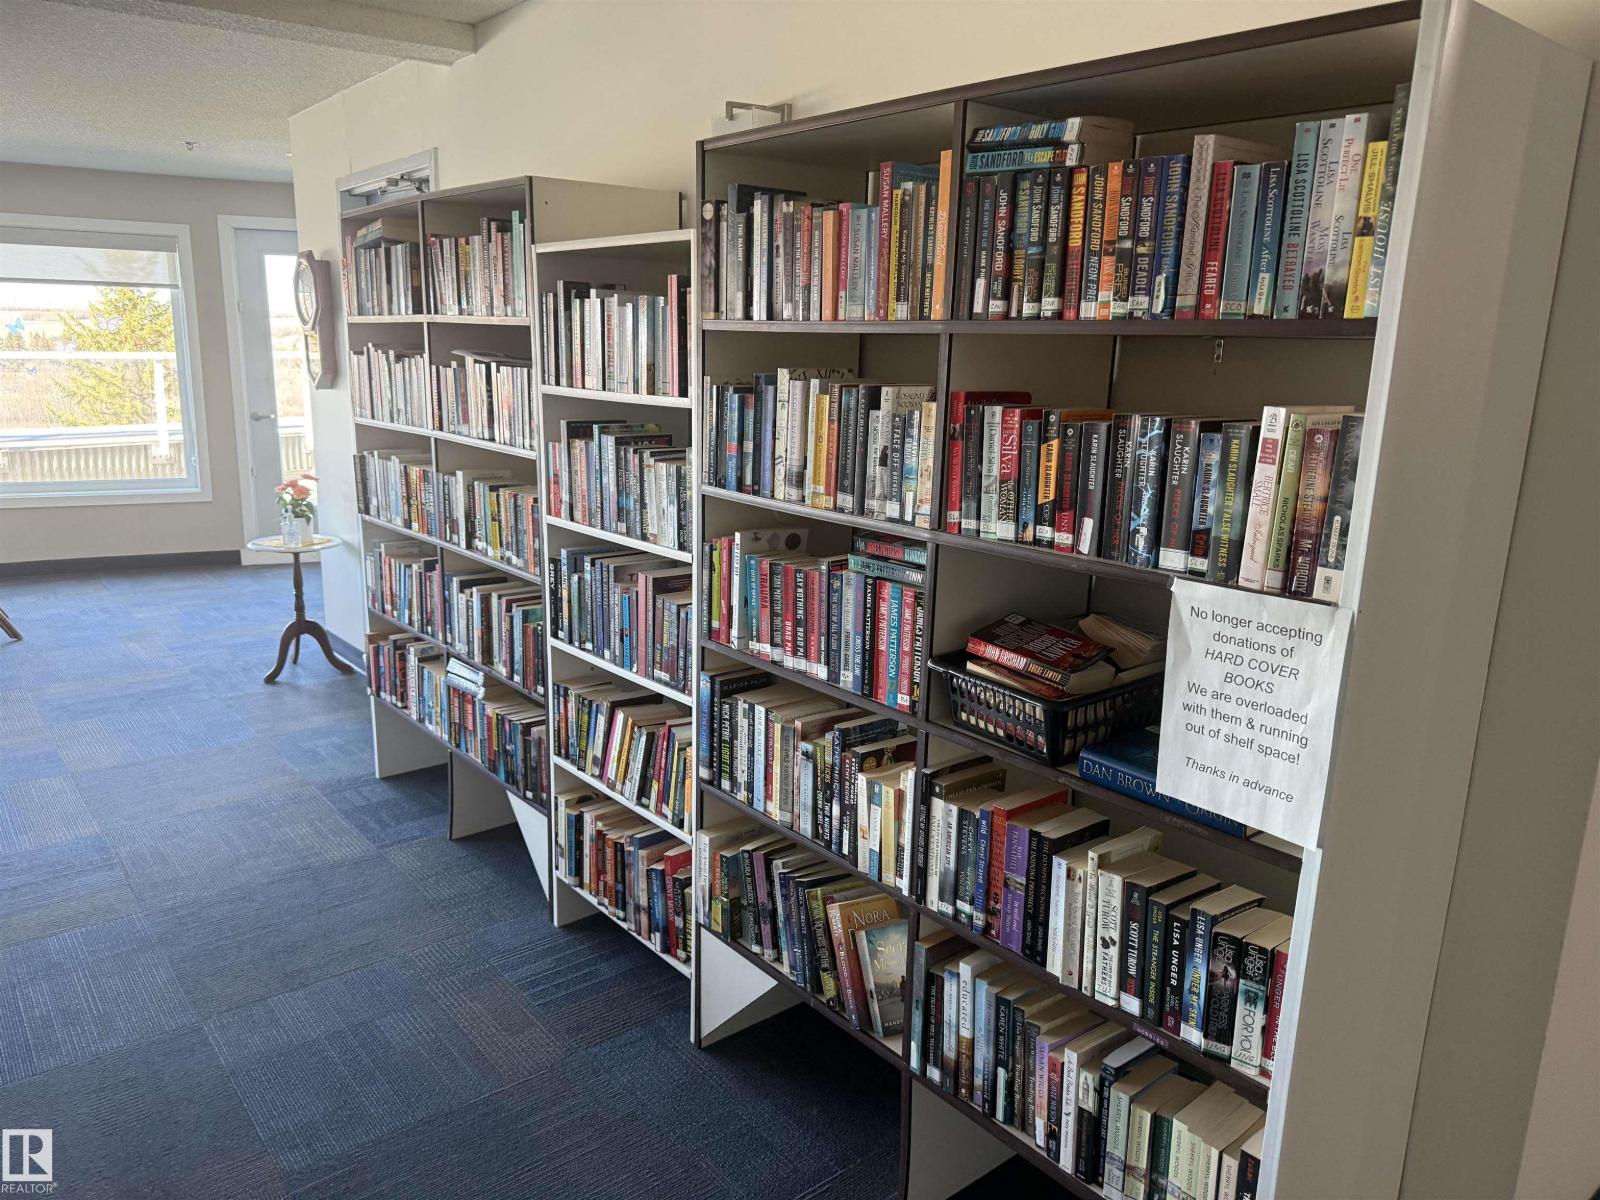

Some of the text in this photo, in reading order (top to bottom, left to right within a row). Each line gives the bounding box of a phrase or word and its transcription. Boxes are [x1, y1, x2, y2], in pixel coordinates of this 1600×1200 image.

[979, 151, 1024, 169] SANDFORD
[1313, 138, 1333, 209] SCOTTOLINE
[1326, 161, 1338, 185] LISA
[1350, 153, 1361, 174] ONE
[1363, 149, 1378, 213] JILL SHALVIS
[881, 167, 891, 239] SUSAN MALLERY
[1030, 185, 1041, 242] JOHN SANDFORD
[1069, 187, 1087, 247] SANDFORD
[1119, 197, 1132, 236] SANDFORD
[1160, 160, 1182, 254] JOHN SANDFORD
[1259, 167, 1279, 273] LISA SCOTTOLINE After
[1282, 153, 1310, 291] LISA SCOTTOLINE BETRAYED
[994, 189, 1007, 271] JOHN SANDFORD
[1049, 205, 1060, 242] SANDFORD
[1088, 174, 1102, 280] JOHN SANDFORD NEON
[1329, 215, 1344, 266] SCOTTOLINE
[1340, 231, 1352, 250] LISA
[1134, 197, 1153, 297] SANDFORD DEADLI
[1366, 201, 1392, 307] LAST HOUSE
[851, 257, 859, 291] MALLERY
[1204, 261, 1217, 295] FEARED
[892, 429, 901, 468] FACE OFF
[1001, 435, 1017, 475] Silva
[1114, 429, 1126, 478] SLAUGHTER
[1123, 441, 1133, 468] KARIN
[1138, 439, 1149, 488] SLAUGHTER
[1148, 450, 1158, 476] KARIN
[1171, 434, 1184, 485] SLAUGHTER
[1181, 446, 1191, 474] KARIN
[1286, 450, 1297, 473] DEAR
[1043, 444, 1053, 500] KARIN SLAUGHTER
[1088, 455, 1096, 490] SLAUGHTER
[999, 482, 1007, 522] WOMAN
[1198, 463, 1212, 526] KARIN SLAUGHTER
[1217, 439, 1240, 568] KARIN SLAUGHTER FALSE WITNESS
[1251, 479, 1263, 508] SMALL
[1259, 475, 1273, 516] BERTRICE
[1272, 497, 1289, 569] NICHOLAS SPARKS
[760, 573, 768, 609] TRAUMA
[1295, 556, 1309, 593] NOBODY
[1190, 605, 1323, 646] No longer accepting
[1213, 630, 1295, 659] donations of
[889, 629, 897, 677] PATTERSON
[999, 650, 1027, 670] GRISHAM
[1204, 648, 1300, 681] HARD COVER
[1187, 681, 1308, 725] We are overloaded
[1223, 672, 1275, 694] BOOKS
[1182, 702, 1309, 749] with them & running
[1185, 721, 1300, 766] out of shelf space!
[1083, 759, 1112, 781] DAN
[1185, 756, 1294, 803] Thanks in advance
[960, 820, 968, 855] STEVENS
[978, 839, 986, 859] Cheryl
[746, 876, 754, 904] ROBERTS
[977, 860, 985, 883] Strayed
[851, 910, 890, 929] NORA
[1101, 899, 1110, 932] TUROW
[1109, 904, 1118, 932] SCOTT
[1100, 951, 1109, 986] FATHERS
[1127, 921, 1139, 978] SCOTT TUROW
[1148, 930, 1160, 1004] THE STRANGER INSIDE
[1169, 922, 1181, 986] LISA UNGER
[1244, 945, 1257, 978] Unger
[1254, 954, 1266, 973] Lisa
[1188, 916, 1206, 1028] LISA UNGER UNDER MY SKIN
[1274, 974, 1283, 1008] UNGER
[960, 980, 970, 1031] educated
[1112, 1097, 1123, 1150] SHERRYL WOODS
